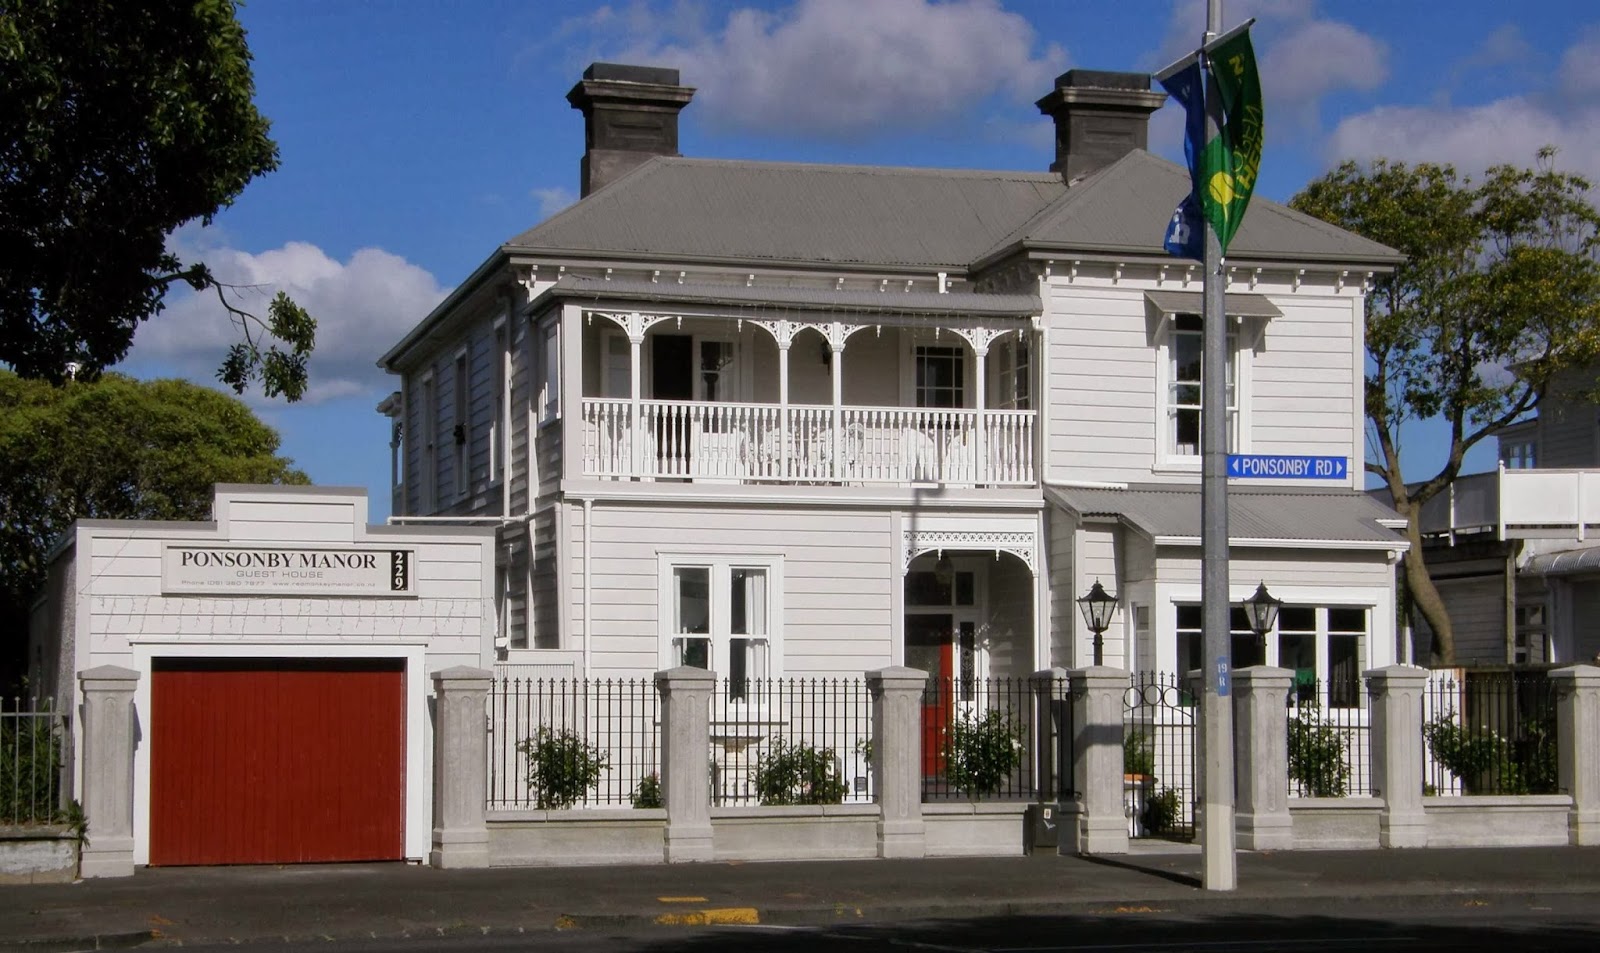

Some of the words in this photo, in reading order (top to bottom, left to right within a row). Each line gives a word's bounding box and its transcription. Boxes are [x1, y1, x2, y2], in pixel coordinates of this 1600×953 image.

[1242, 458, 1311, 475] PONSONBY
[1315, 459, 1333, 476] RD
[181, 551, 295, 568] PONSONBY
[299, 553, 377, 569] MANOR
[236, 570, 277, 578] GUEST
[282, 571, 324, 579] HOUSE
[1217, 663, 1228, 673] 19
